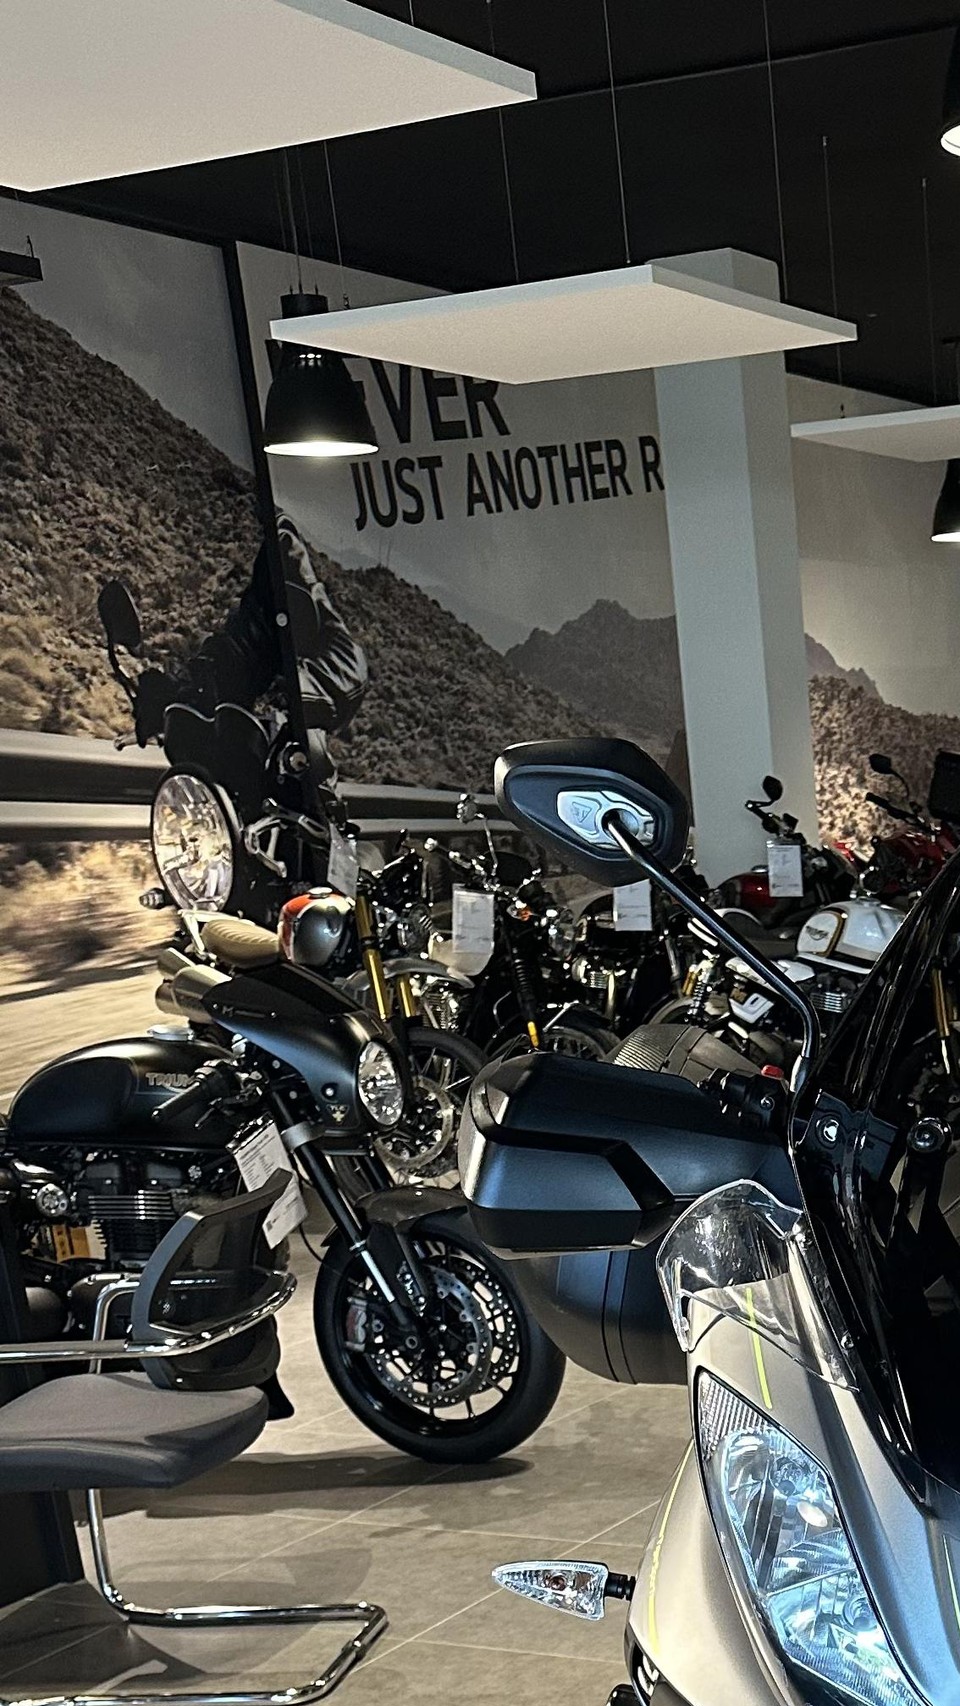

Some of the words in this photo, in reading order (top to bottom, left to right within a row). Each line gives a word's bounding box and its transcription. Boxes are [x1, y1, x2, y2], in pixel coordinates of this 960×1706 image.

[350, 455, 444, 531] JUST
[466, 438, 633, 517] ANOTHER
[638, 435, 665, 493] R
[145, 1072, 195, 1088] TRIUM
